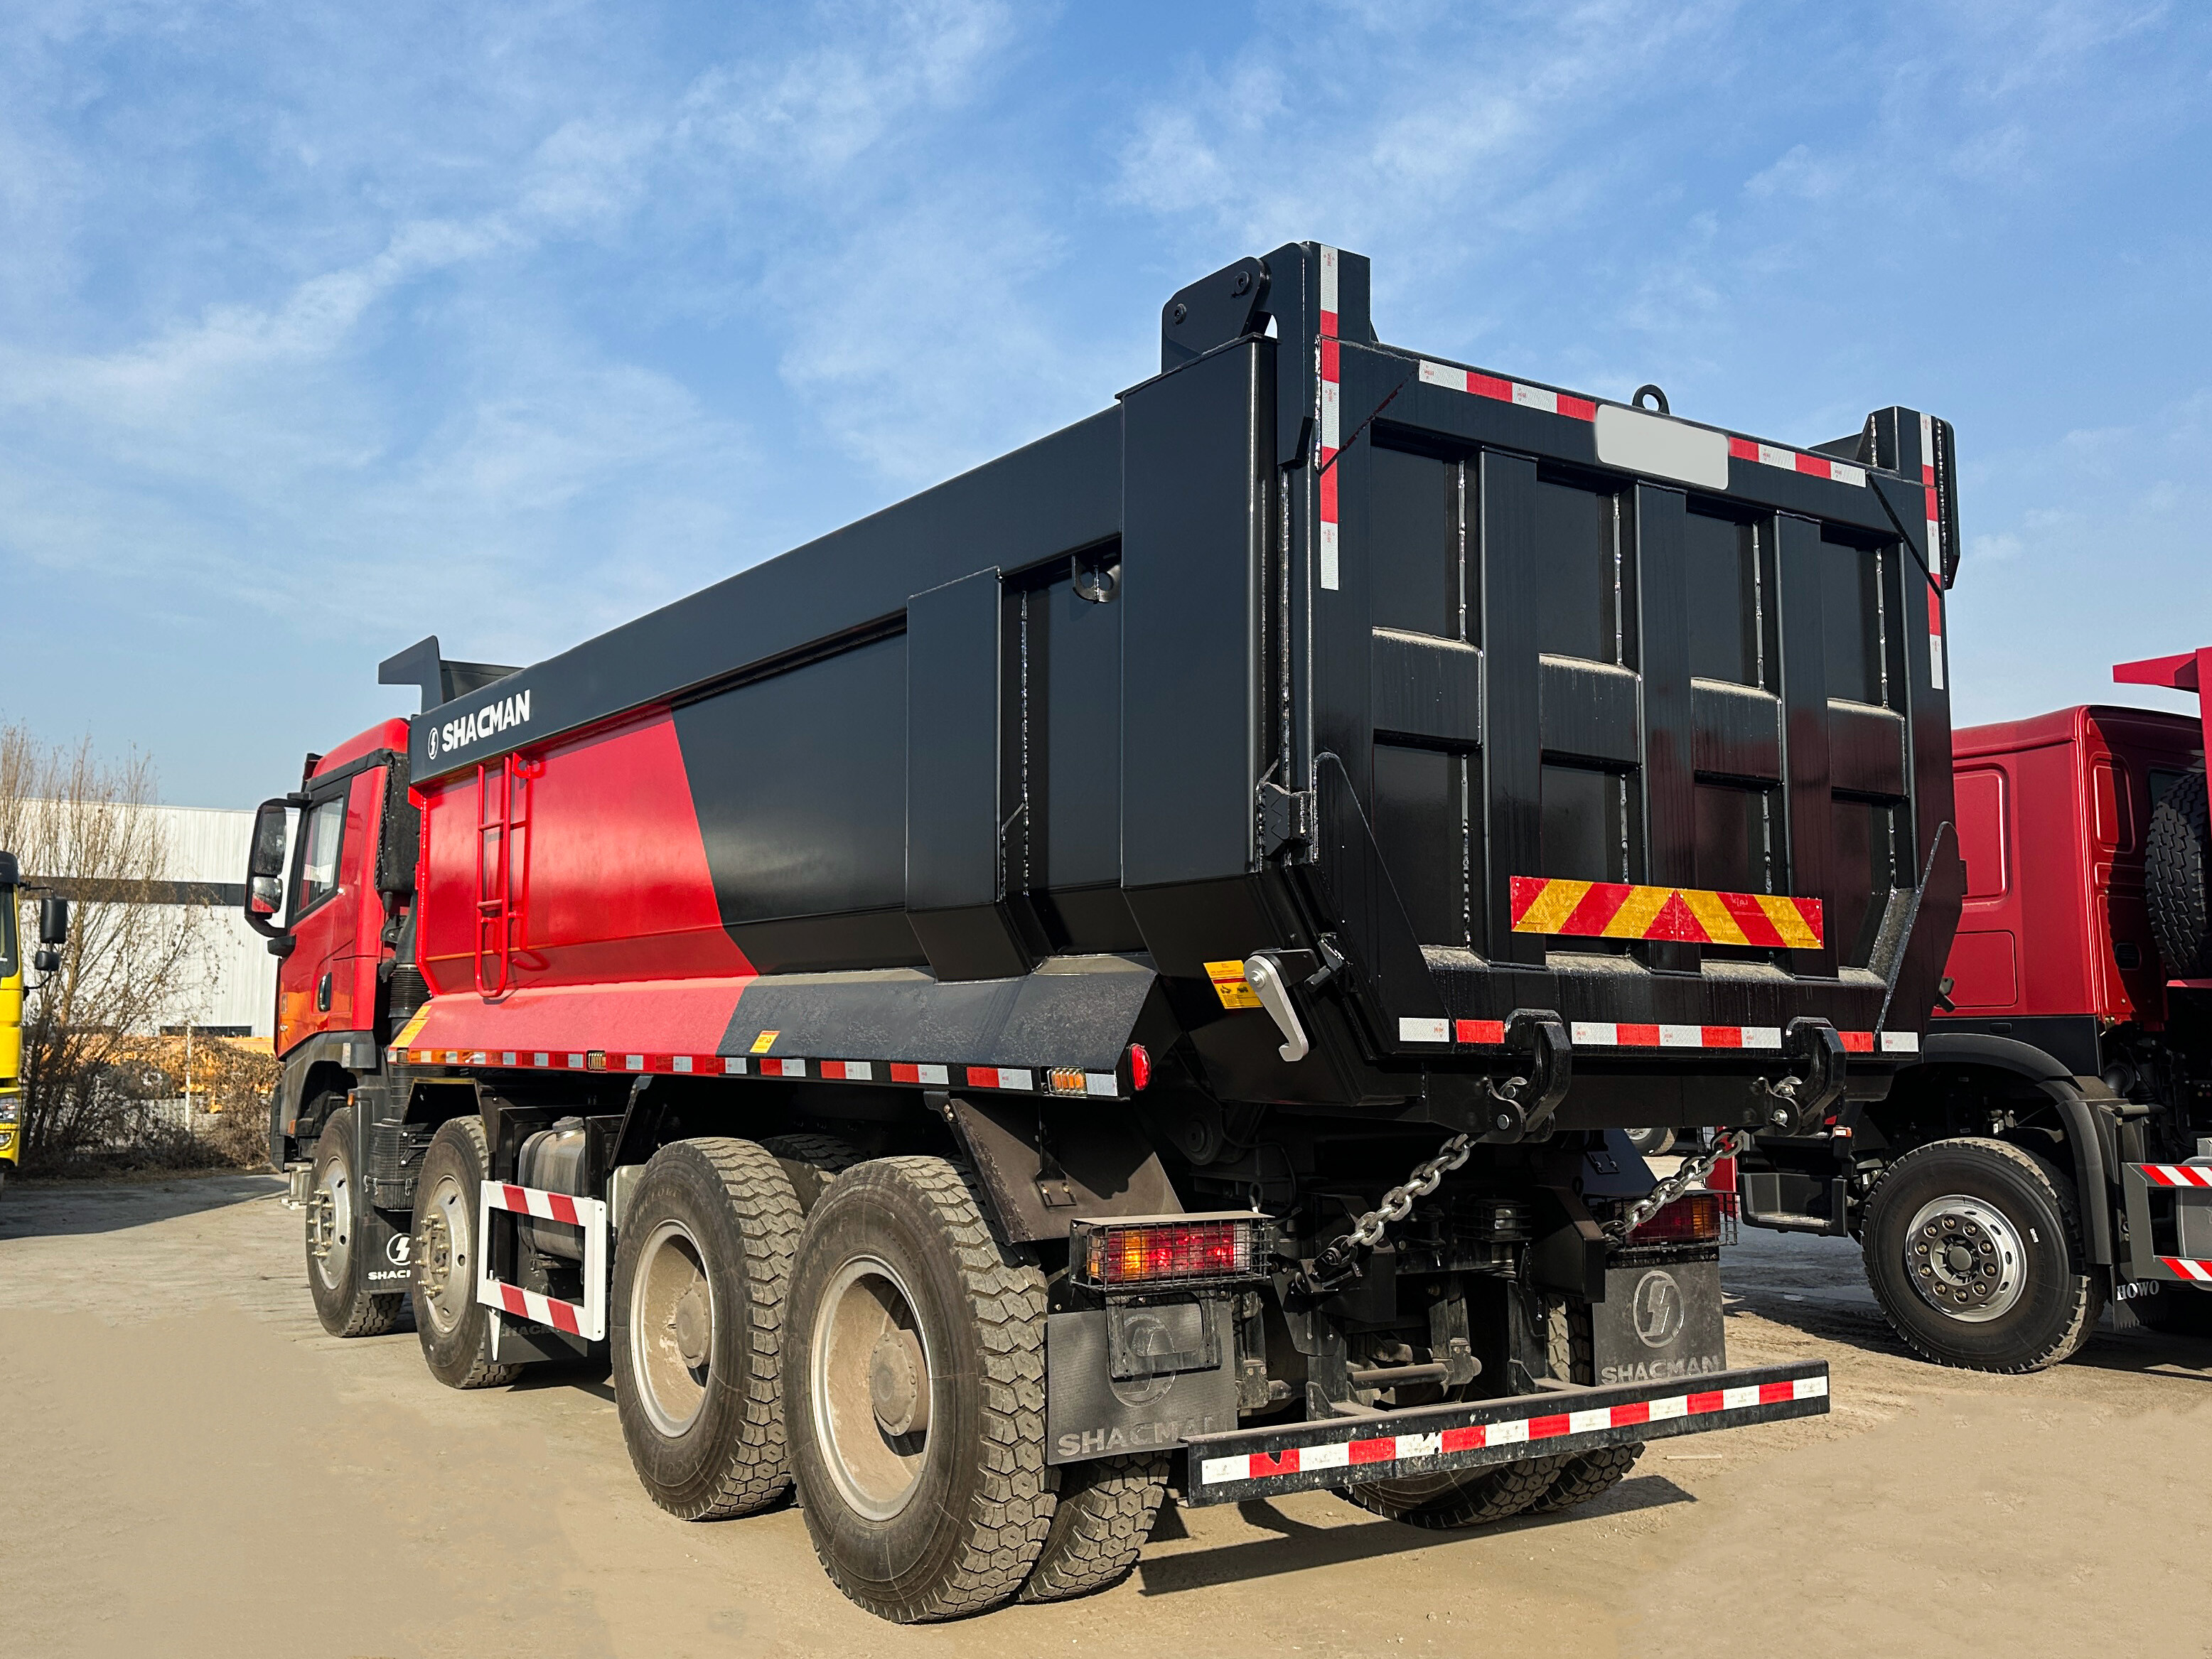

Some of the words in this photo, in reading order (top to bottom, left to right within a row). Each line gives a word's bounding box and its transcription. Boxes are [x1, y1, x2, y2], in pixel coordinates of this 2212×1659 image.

[442, 689, 530, 752] SHACMAN
[368, 1269, 411, 1280] SHAC
[2117, 1280, 2159, 1301] HOWO
[1601, 1355, 1719, 1385] SHACMAN
